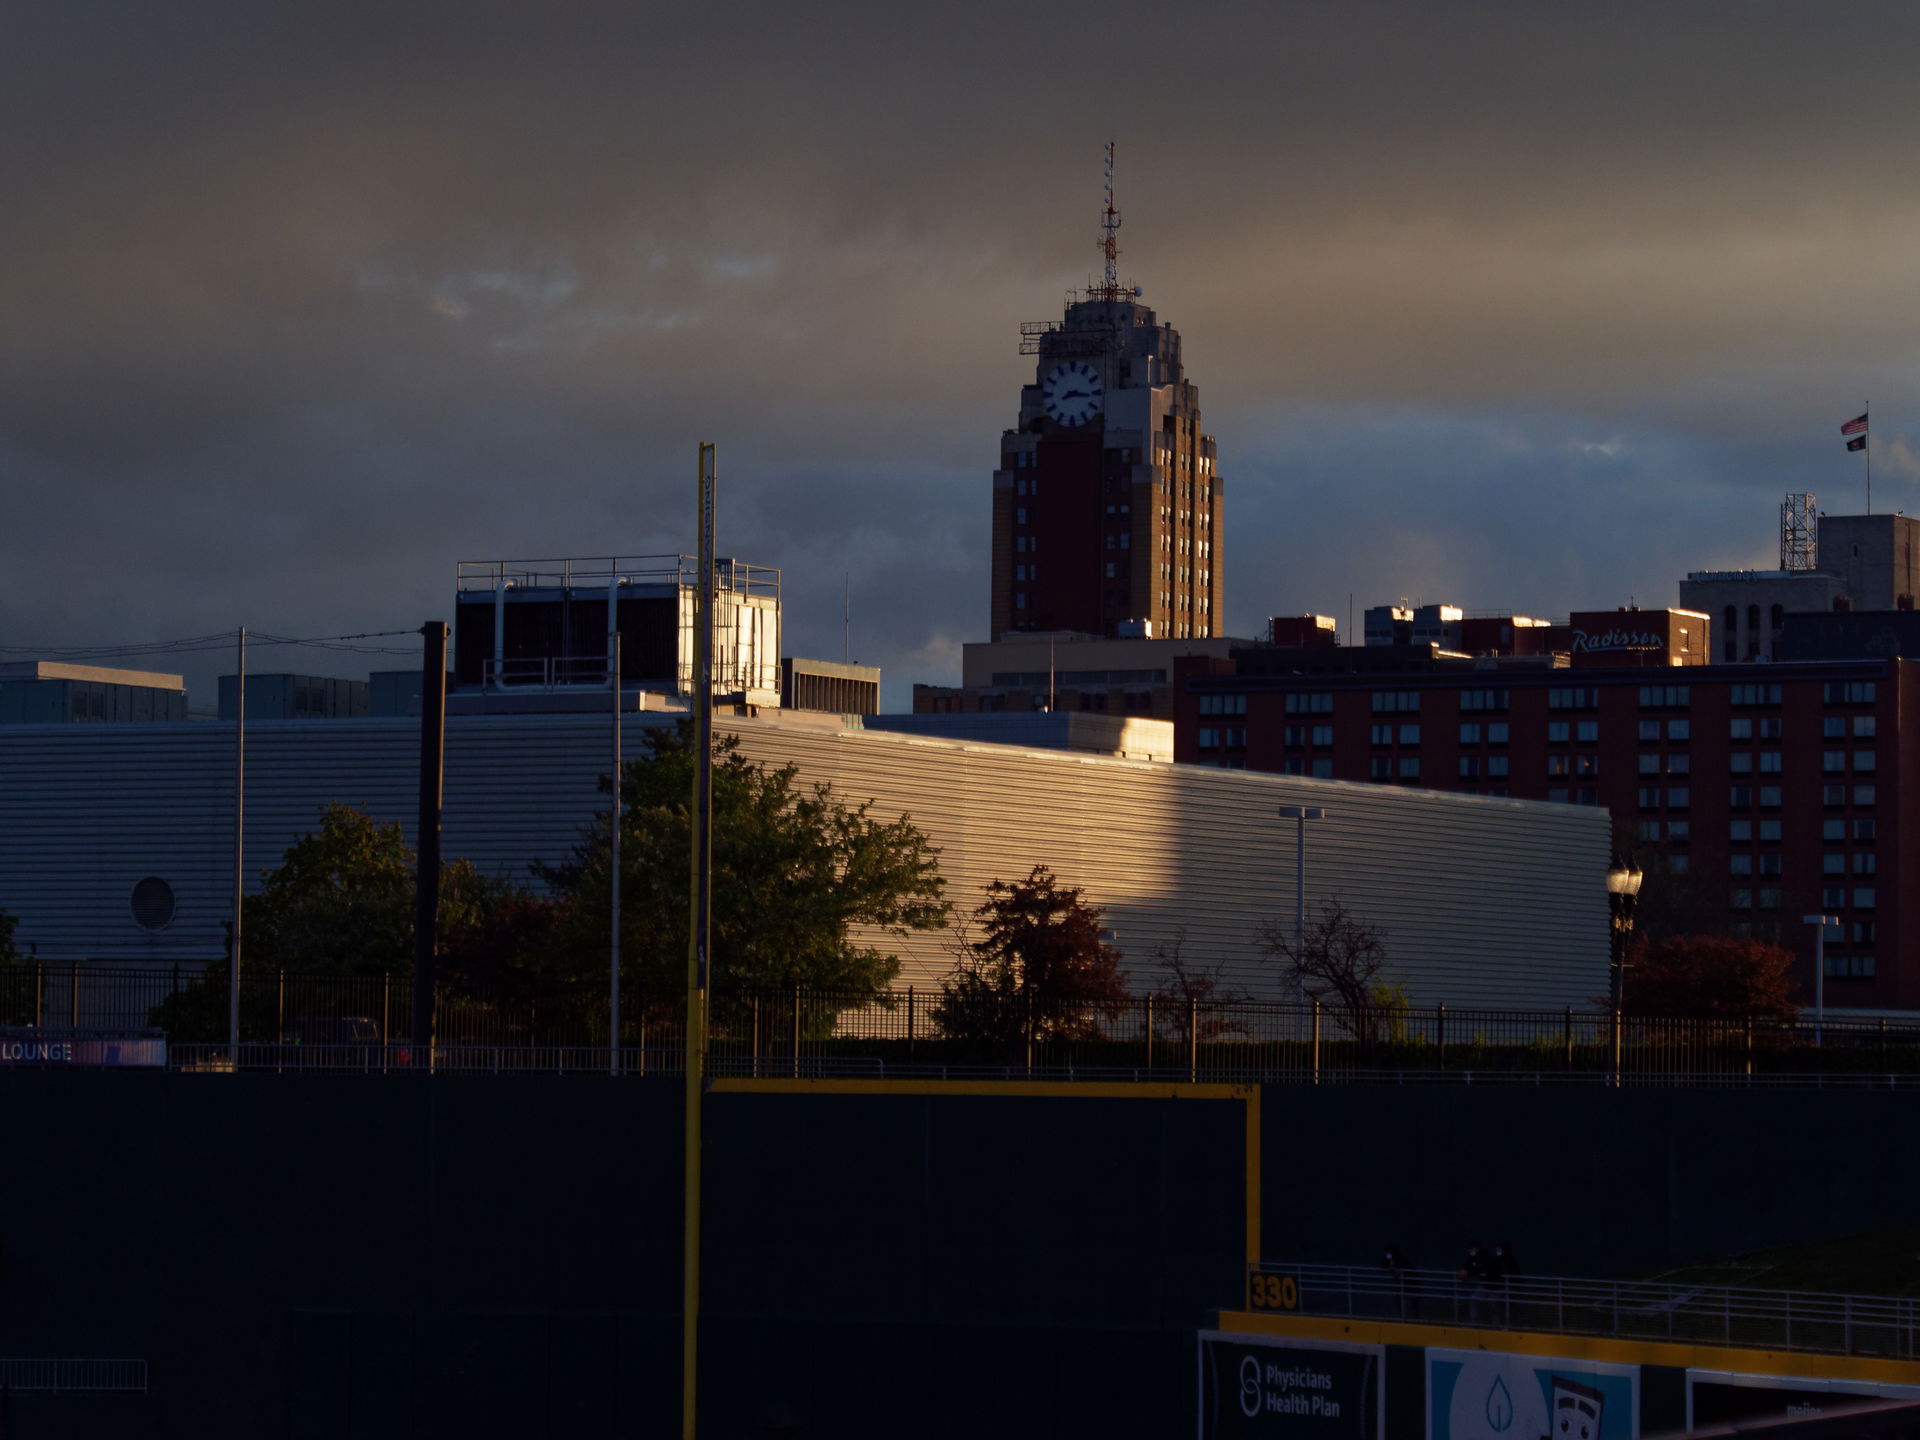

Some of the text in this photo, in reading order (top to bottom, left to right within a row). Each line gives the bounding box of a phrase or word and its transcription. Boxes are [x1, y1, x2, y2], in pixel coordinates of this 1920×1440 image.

[1571, 628, 1664, 651] Radisson
[2, 1042, 72, 1060] LOUNGE
[1251, 1273, 1297, 1310] 330
[1266, 1363, 1333, 1392] Physicians
[1266, 1391, 1341, 1418] Health Plan
